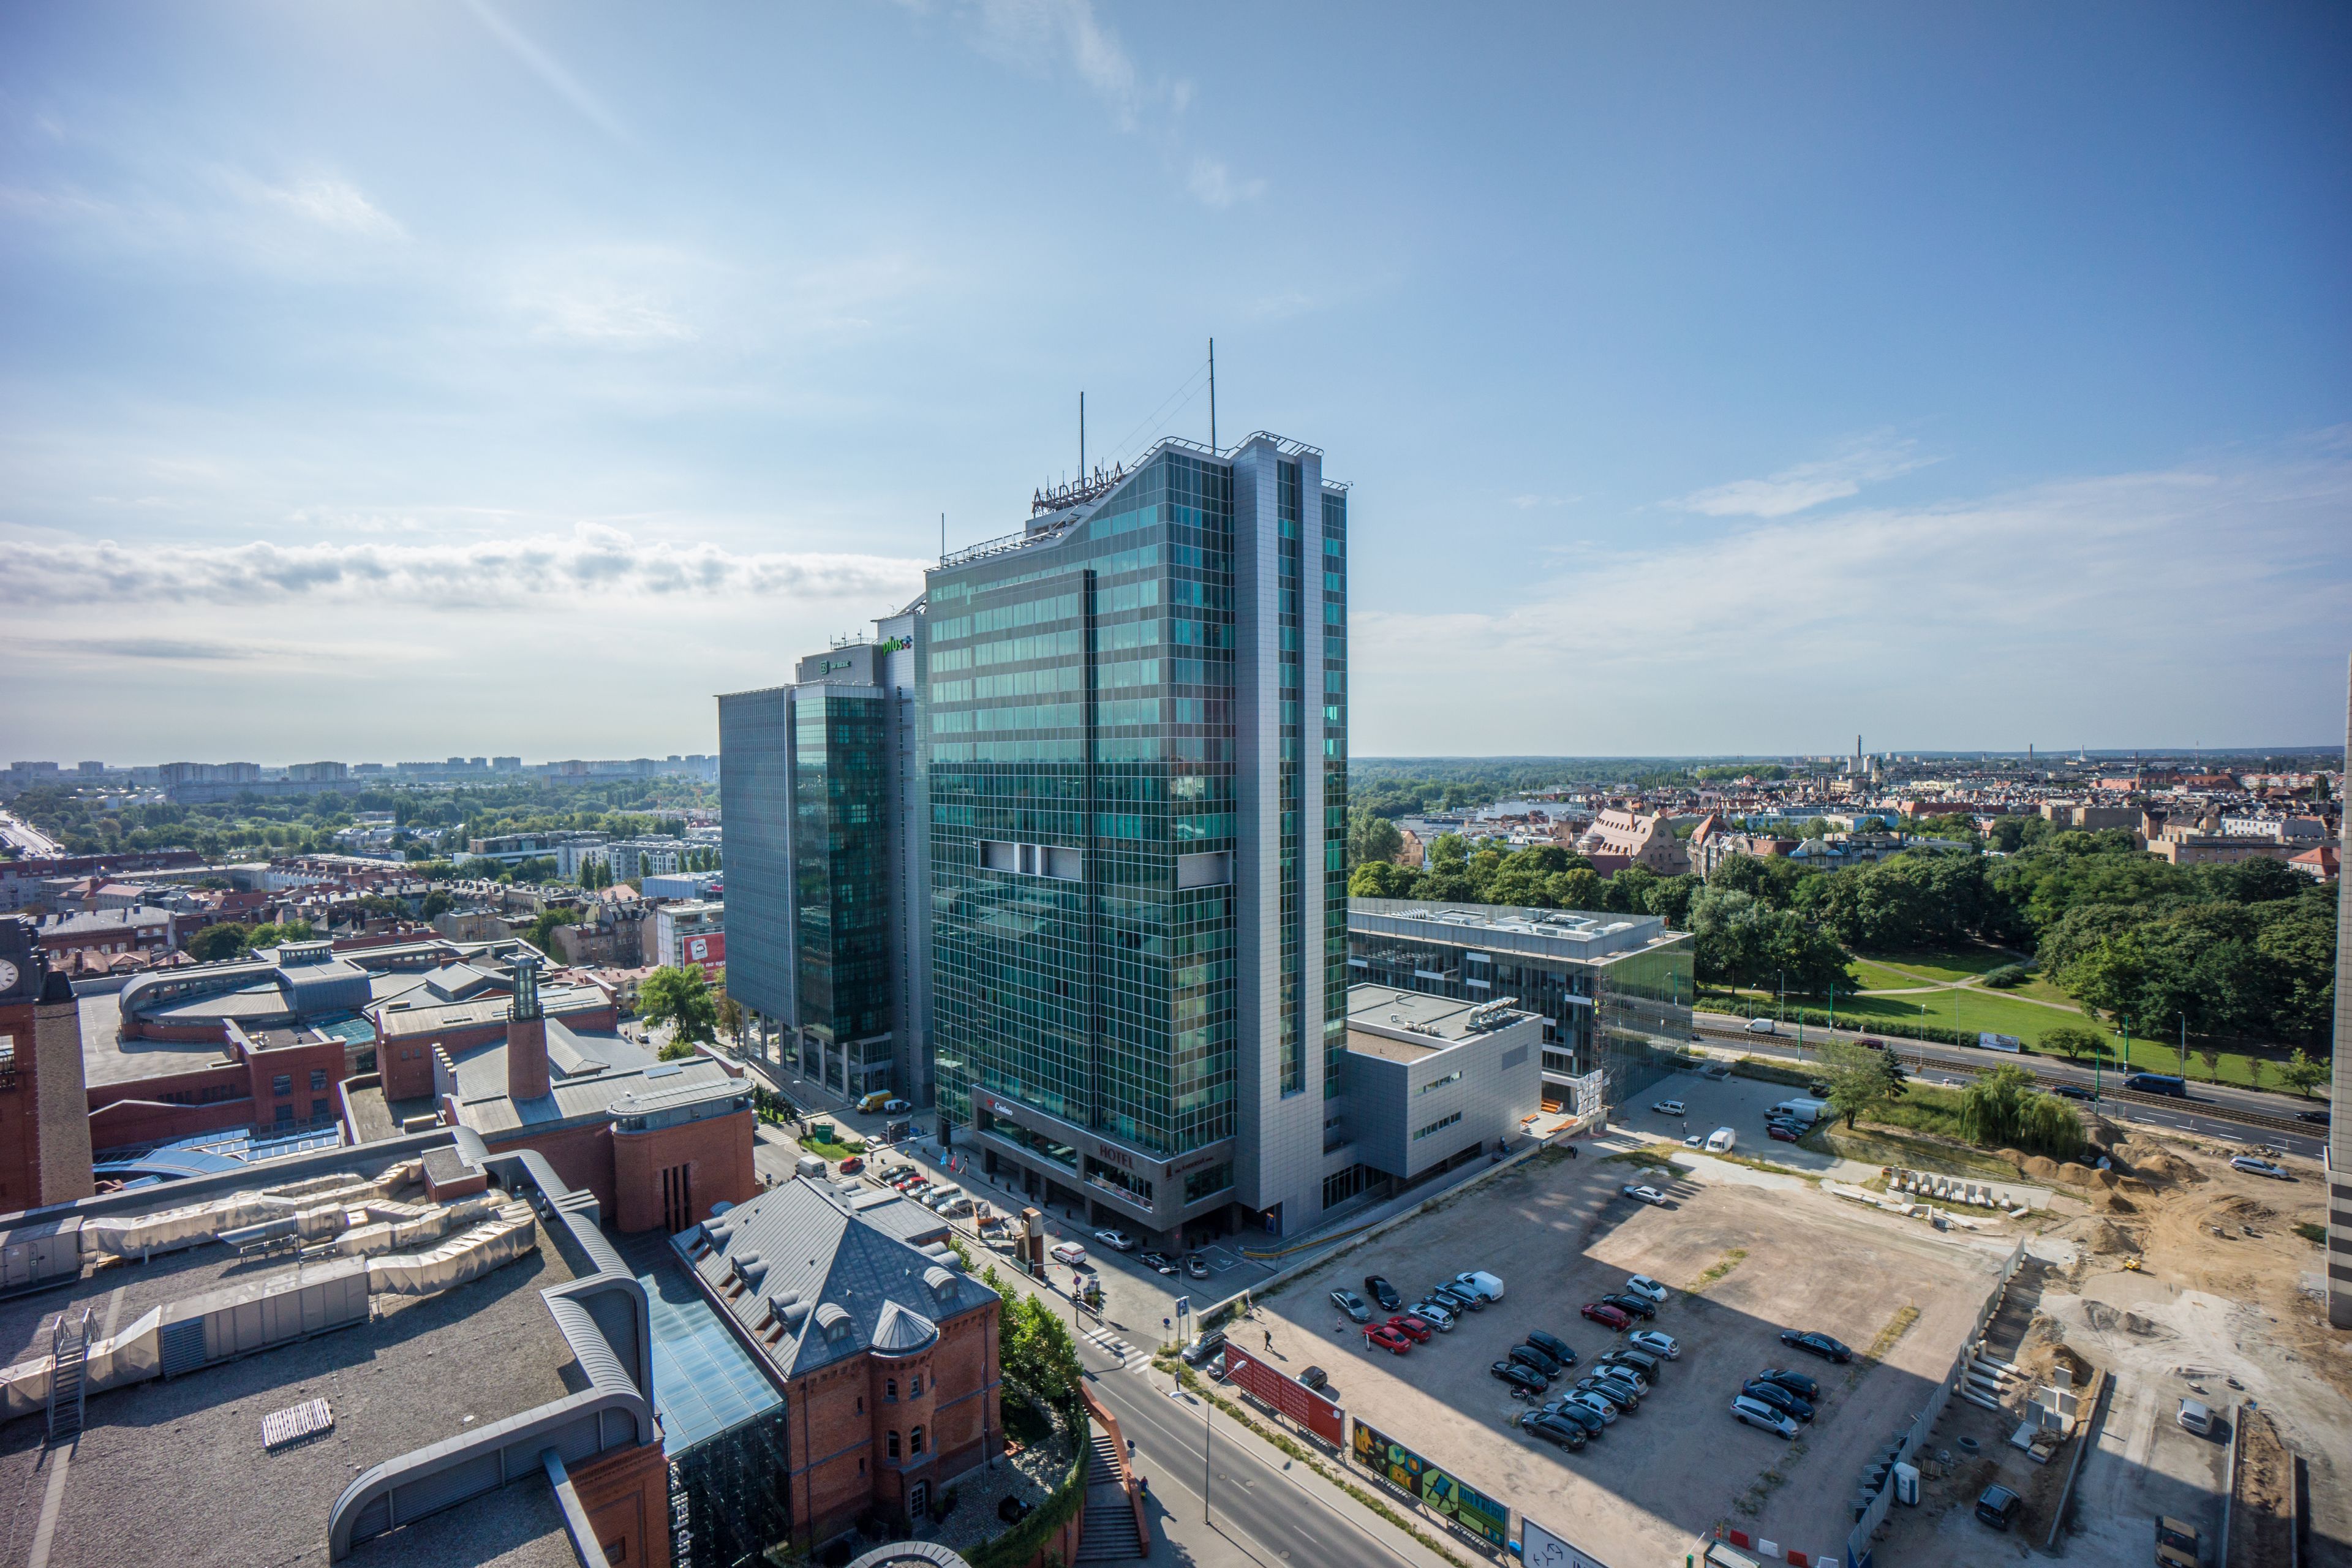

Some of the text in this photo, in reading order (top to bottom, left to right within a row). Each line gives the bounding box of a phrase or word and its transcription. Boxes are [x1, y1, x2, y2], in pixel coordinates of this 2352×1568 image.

[883, 636, 902, 657] plus
[830, 660, 850, 669] WBK
[995, 1102, 1013, 1116] Casino
[1099, 1144, 1134, 1170] HOTEL
[671, 1491, 689, 1530] hall
[676, 1529, 695, 1554] up
